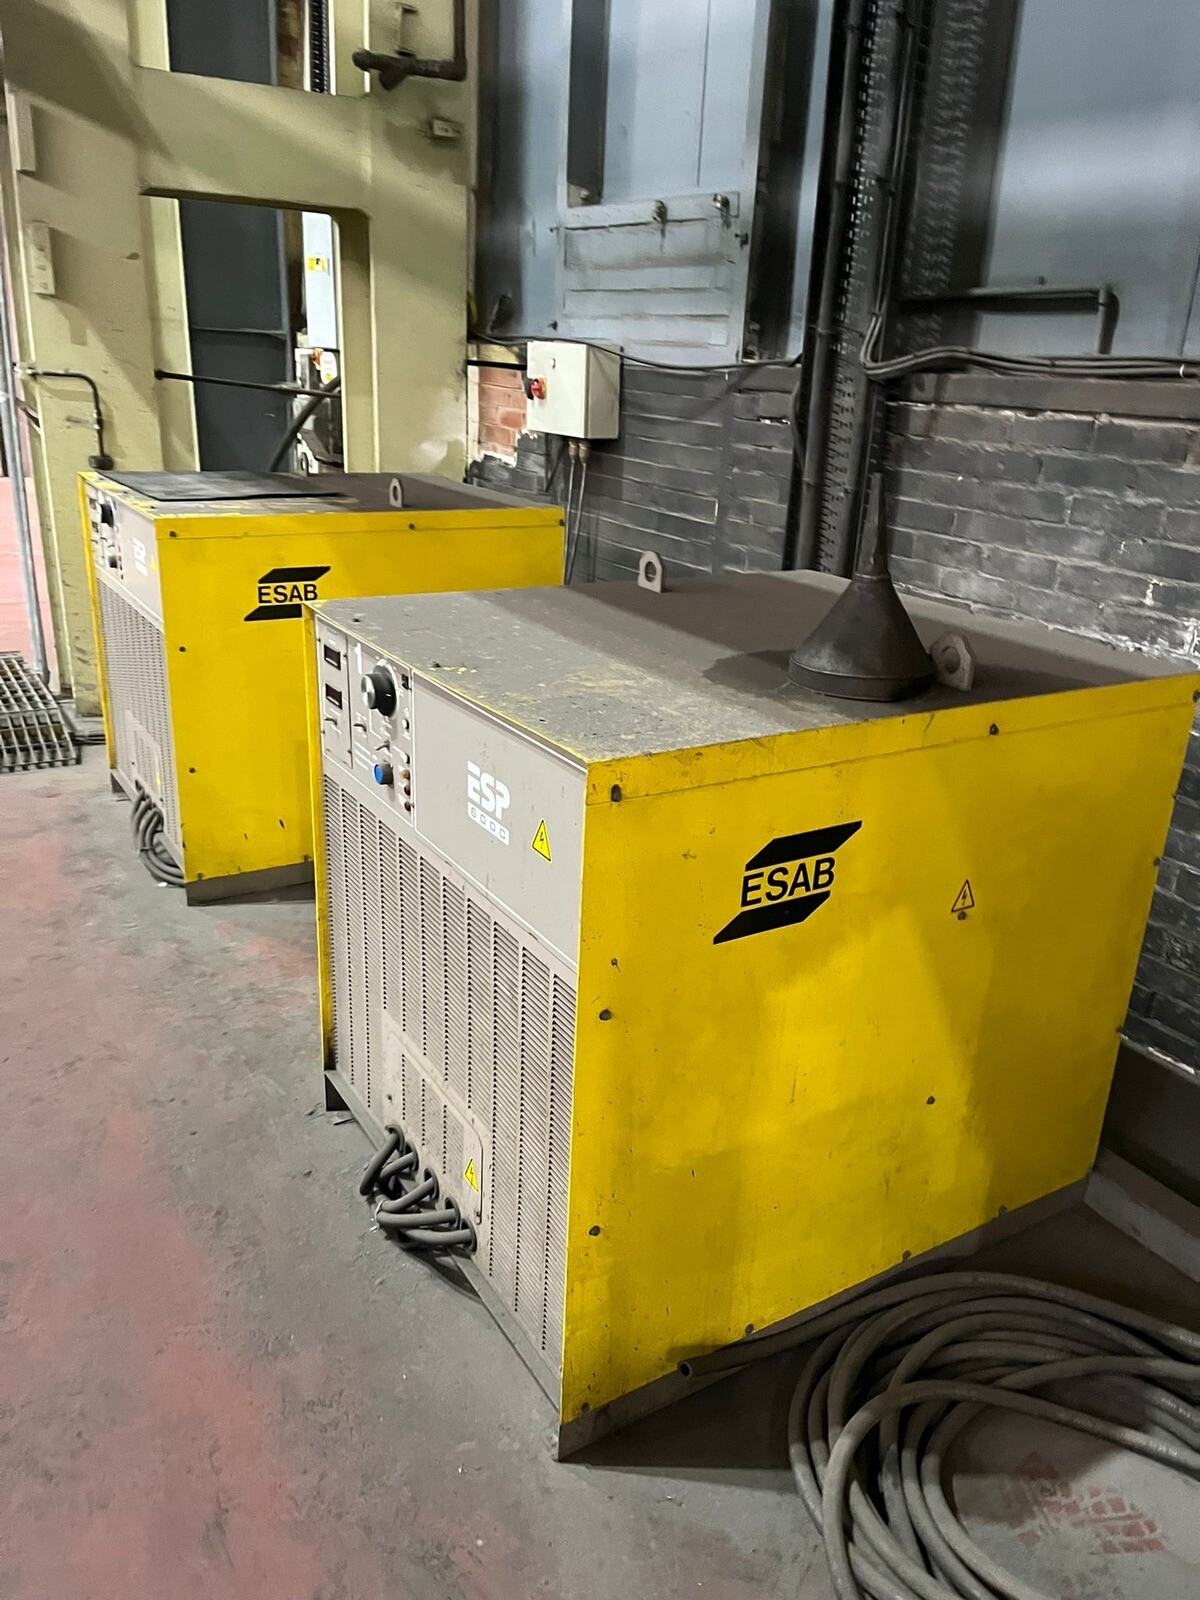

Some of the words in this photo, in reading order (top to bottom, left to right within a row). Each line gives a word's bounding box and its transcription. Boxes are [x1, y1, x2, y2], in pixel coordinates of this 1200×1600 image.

[258, 583, 318, 604] ESAB
[467, 760, 510, 820] ESP
[741, 856, 836, 908] ESAB
